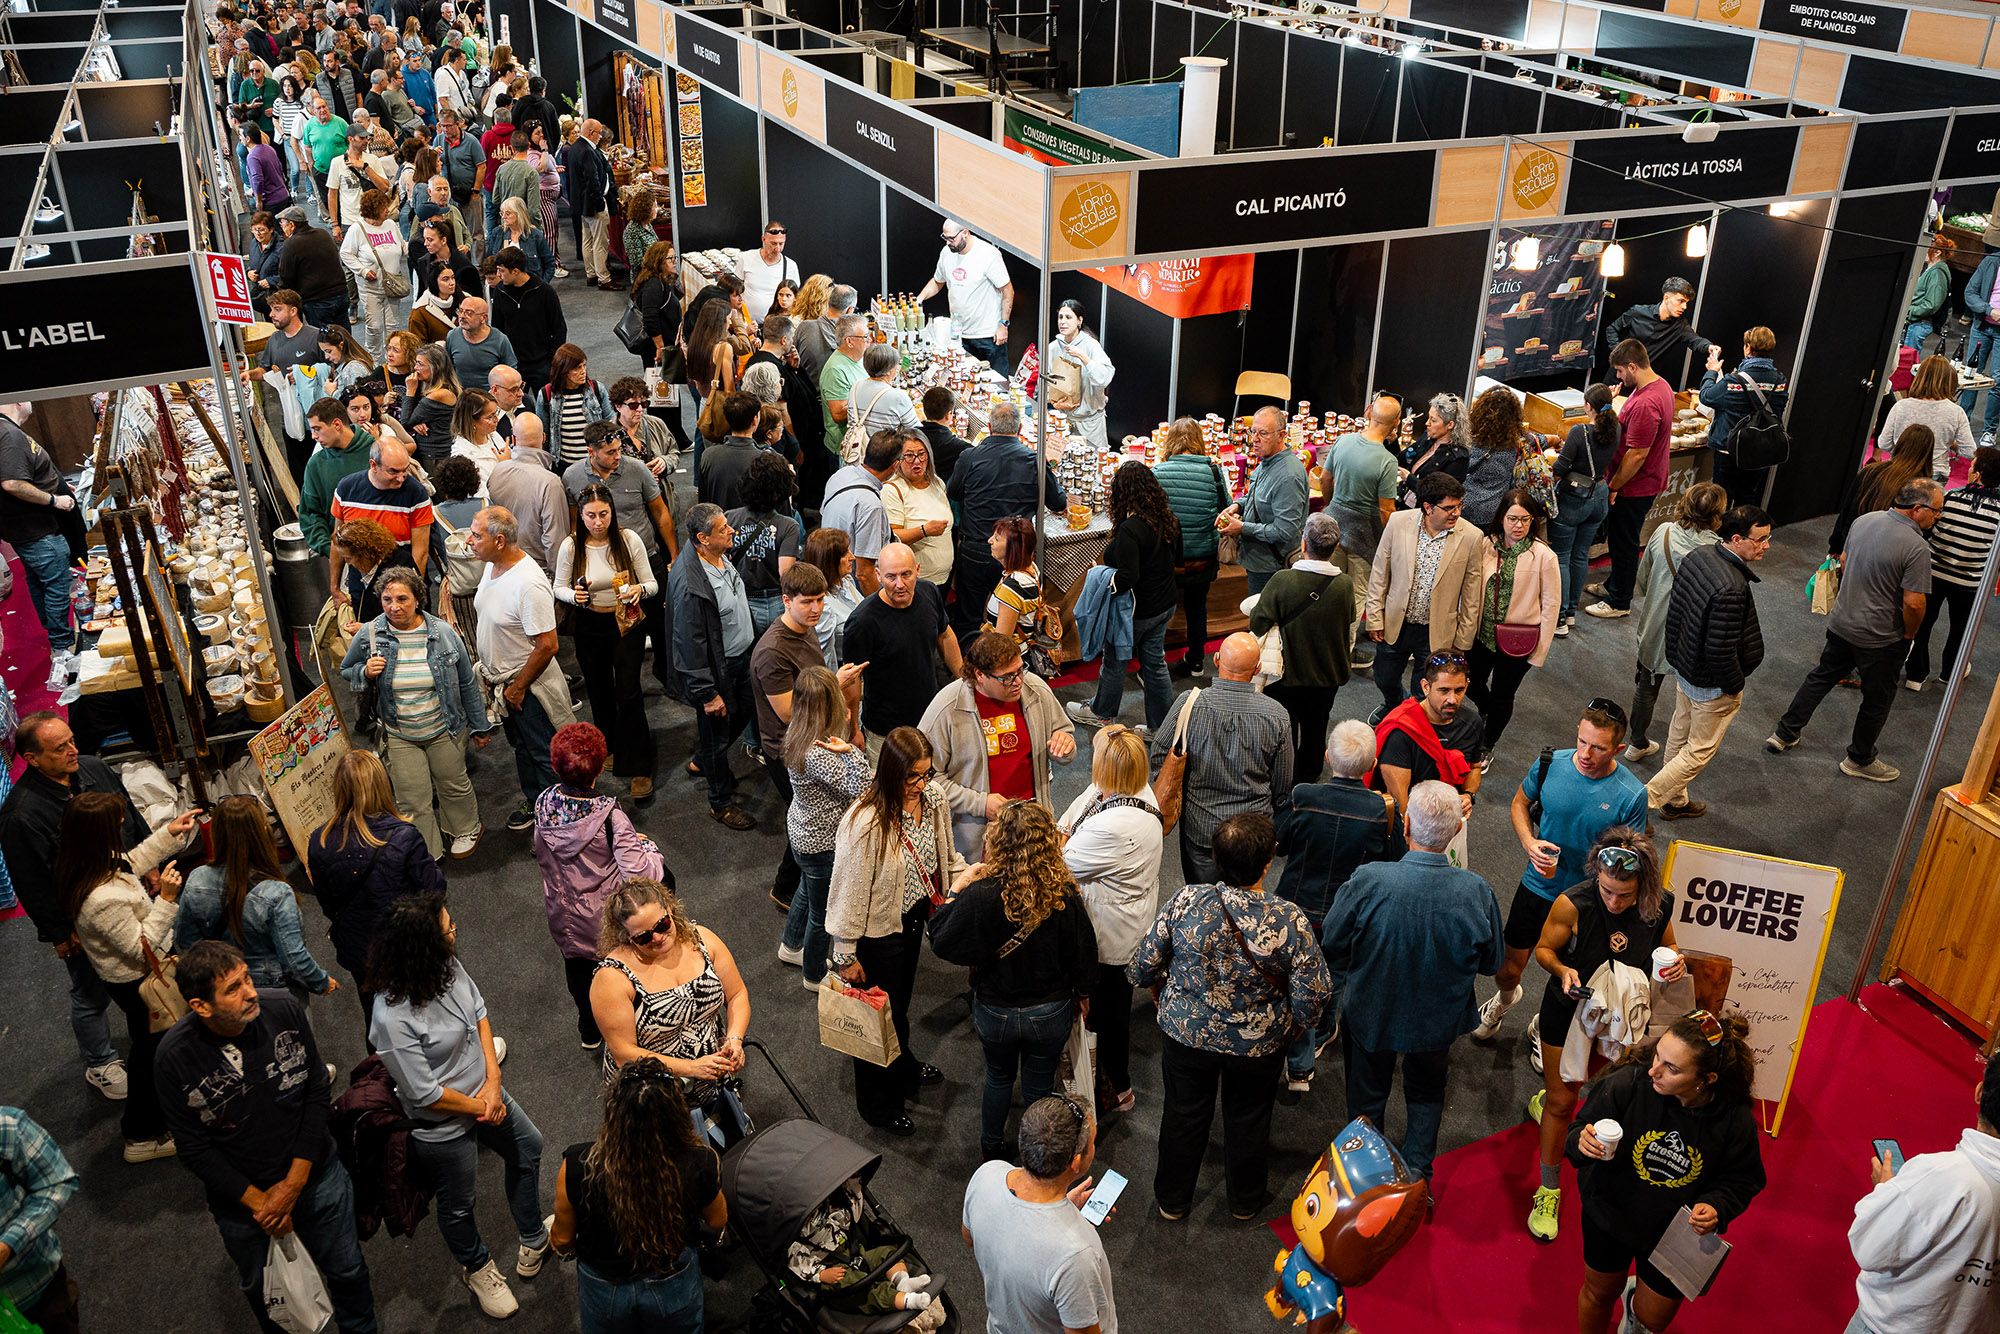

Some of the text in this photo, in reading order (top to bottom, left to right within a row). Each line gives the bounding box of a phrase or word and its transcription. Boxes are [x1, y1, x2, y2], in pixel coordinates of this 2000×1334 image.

[1789, 4, 1876, 26] EMBOTITS CASOLANS
[1800, 17, 1857, 35] DE PLANOLES
[856, 120, 897, 152] CAL SENZILL
[1023, 124, 1057, 148] CONSERVES
[1058, 138, 1091, 161] VEGETALS
[1091, 151, 1101, 164] DE
[1624, 158, 1743, 181] LÀCTICS LA TOSSA
[1235, 187, 1347, 216] CAL PICANTÓ
[1489, 278, 1523, 295] àctics
[217, 306, 252, 319] EXTINTOR
[1, 320, 106, 351] L'ABEL
[1686, 877, 1805, 918] COFFEE
[1679, 901, 1799, 942] LOVERS
[1737, 979, 1799, 994] especialitat
[1648, 1141, 1691, 1168] CrossFit
